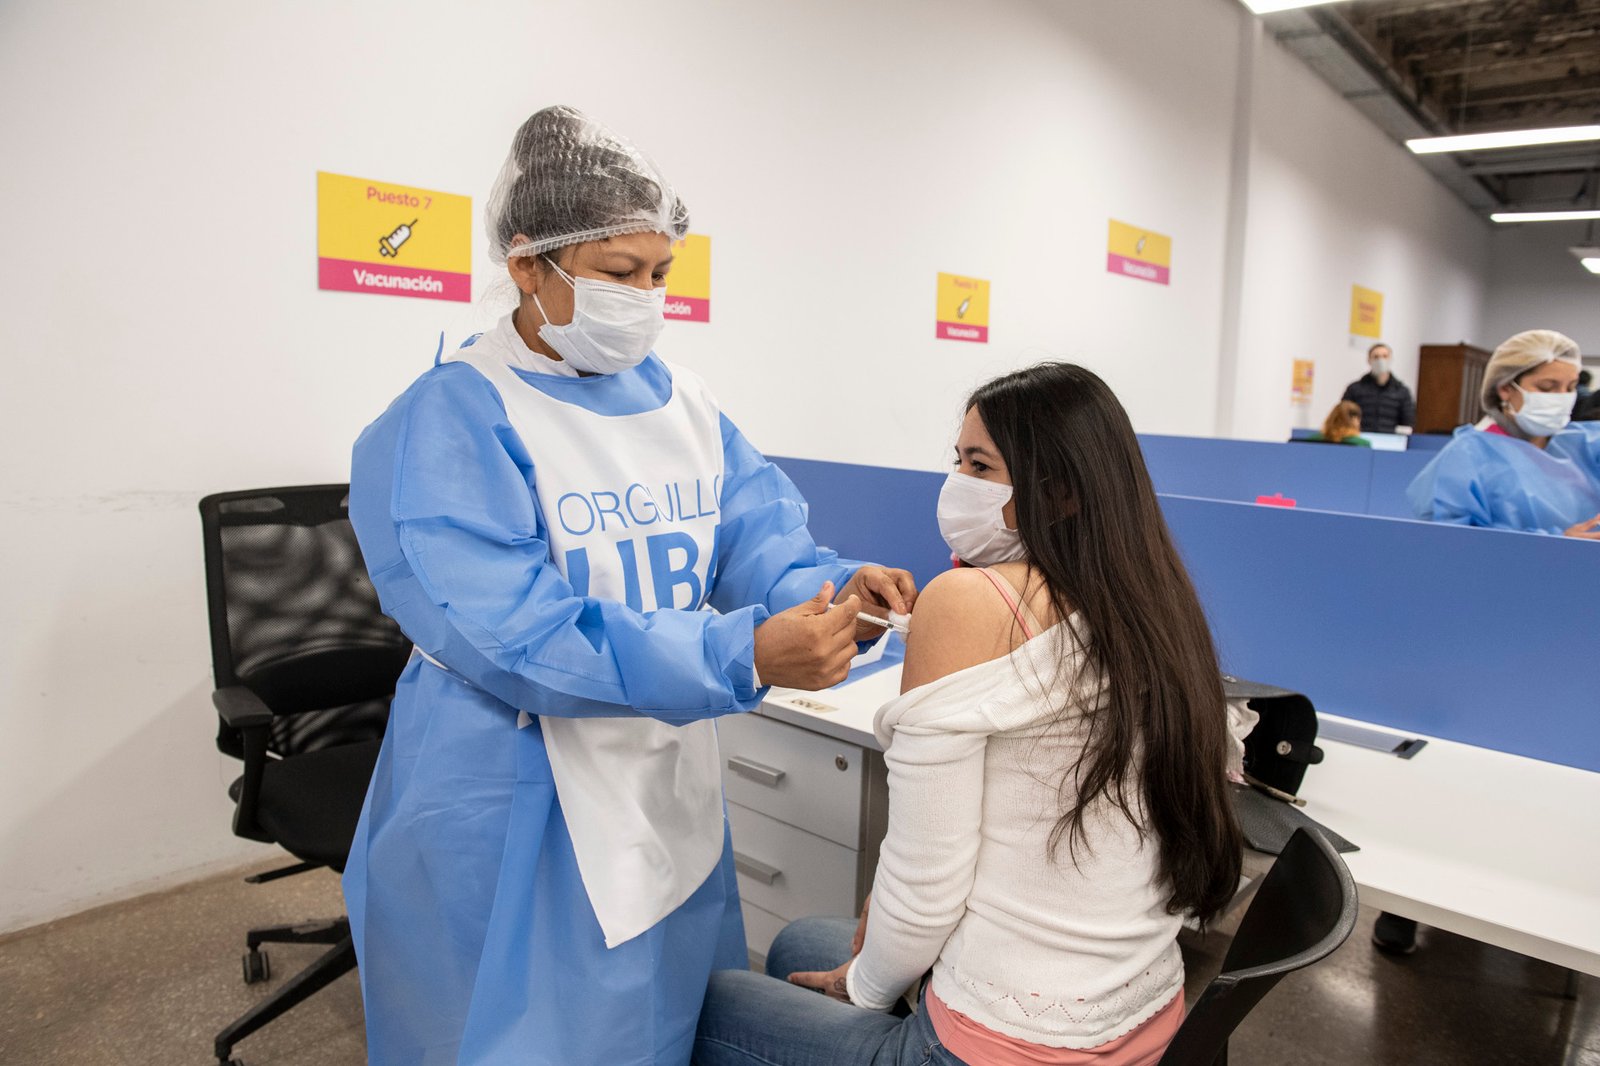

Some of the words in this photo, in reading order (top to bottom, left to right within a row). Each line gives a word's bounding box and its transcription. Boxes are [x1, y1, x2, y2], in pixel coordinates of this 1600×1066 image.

[367, 185, 419, 208] Puesto
[424, 196, 433, 210] 7
[352, 267, 444, 293] Vacunación
[664, 302, 692, 315] ación
